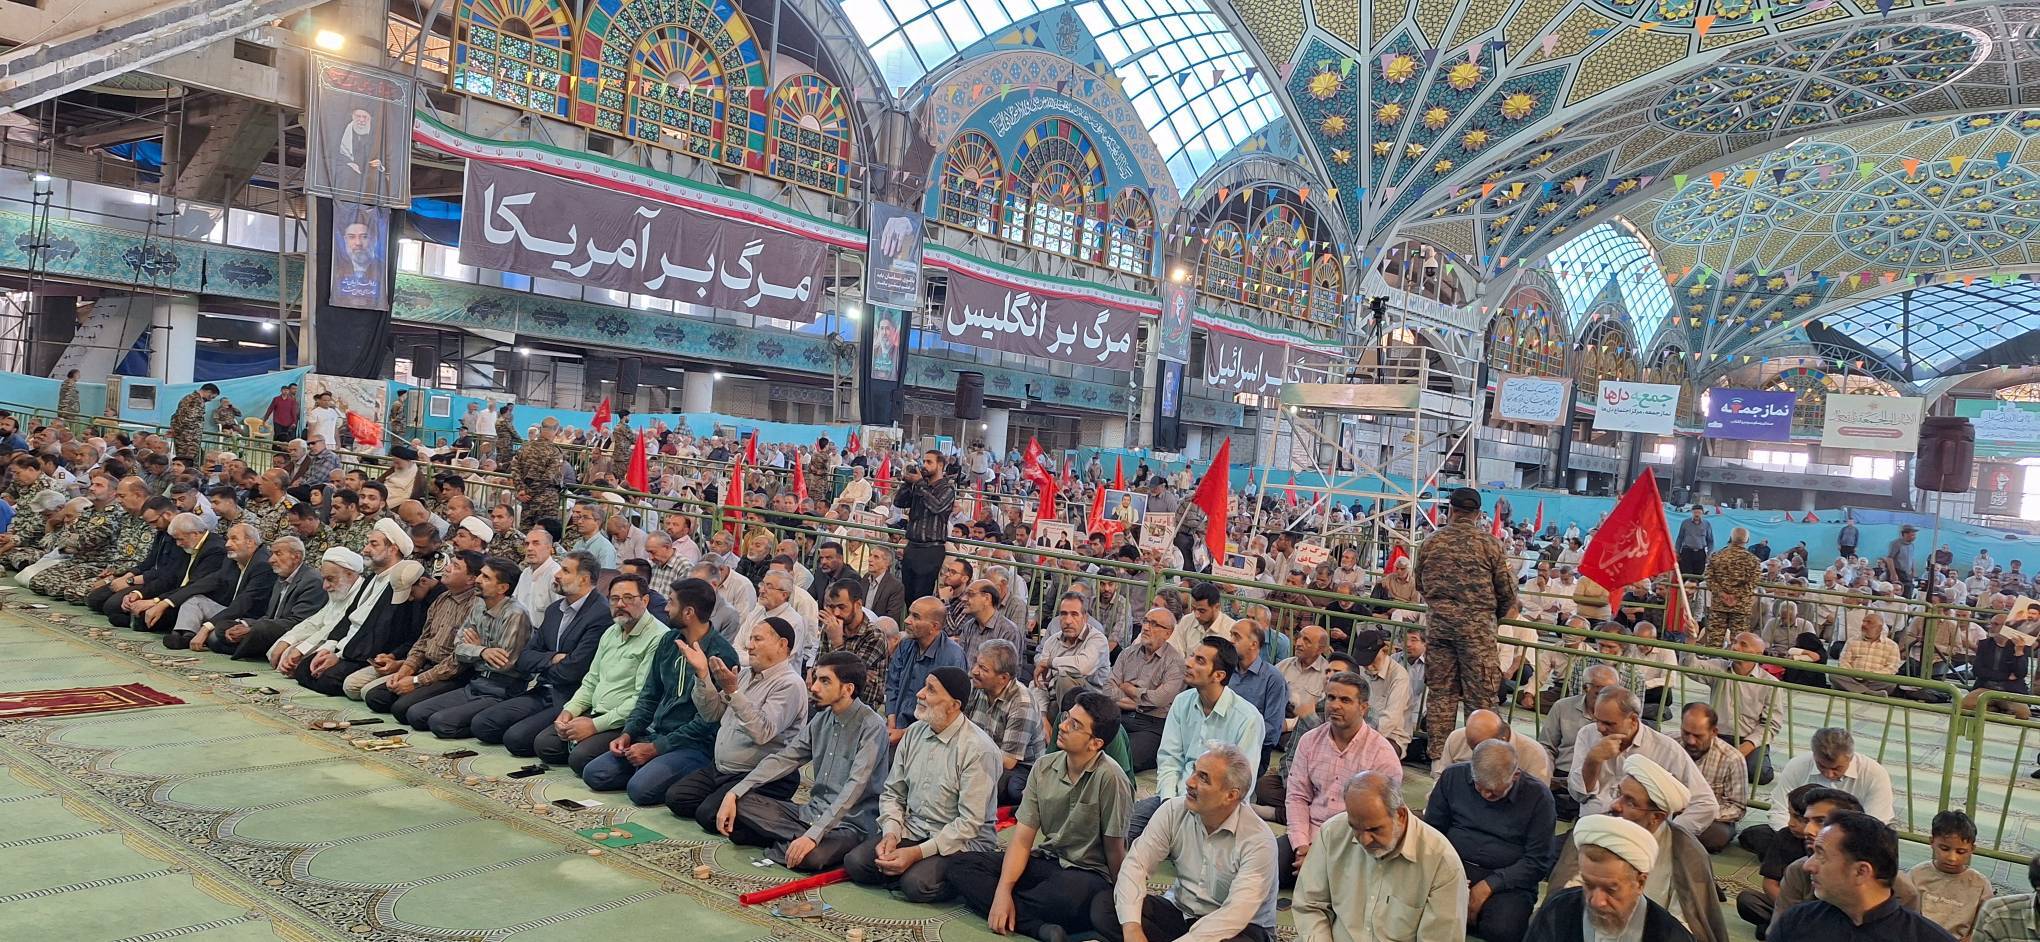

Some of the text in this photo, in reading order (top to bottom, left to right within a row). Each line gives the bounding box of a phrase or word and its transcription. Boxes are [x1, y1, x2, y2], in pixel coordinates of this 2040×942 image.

[483, 182, 813, 307] مرگ بر آمریکا
[946, 291, 1048, 341] انگلیس
[1046, 320, 1078, 356] بر
[1083, 308, 1131, 362] مرگ
[1207, 343, 1264, 389] اسرائیل
[1760, 404, 1790, 418] نماز
